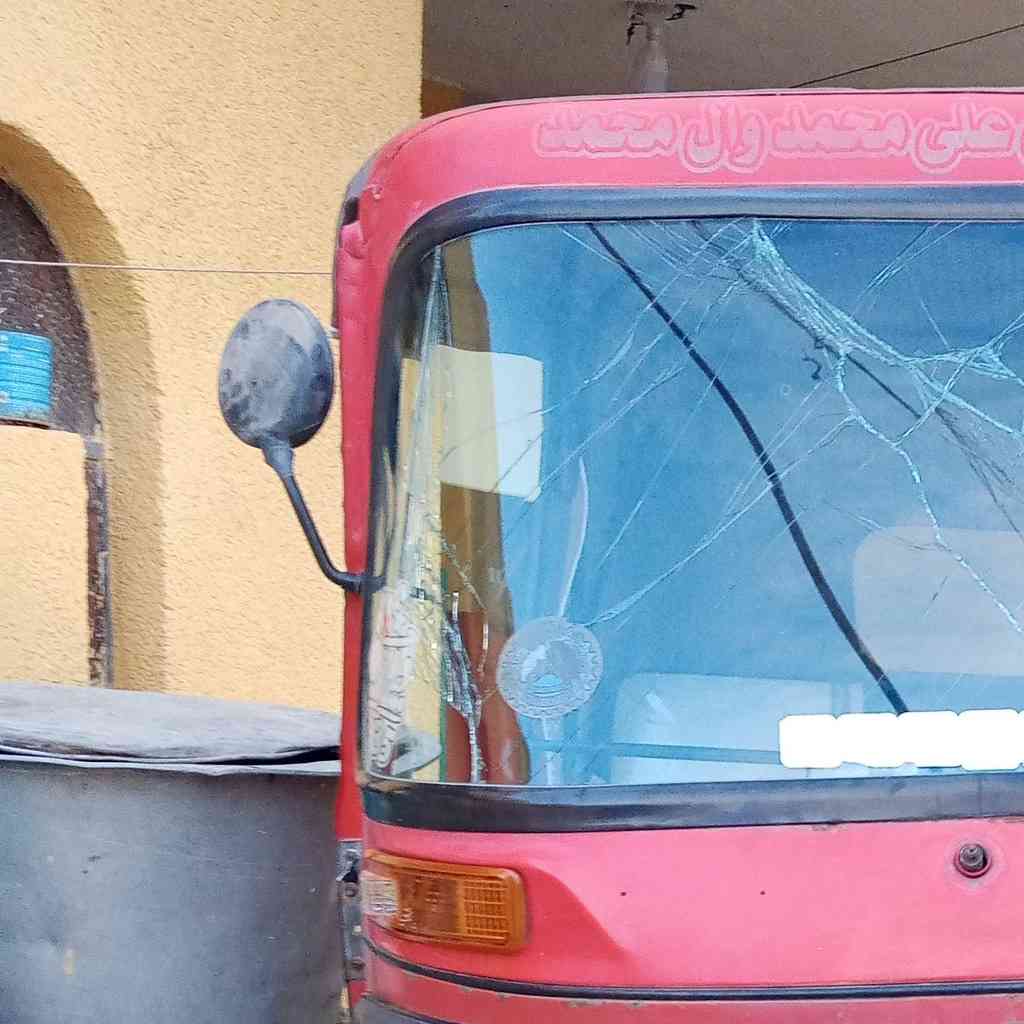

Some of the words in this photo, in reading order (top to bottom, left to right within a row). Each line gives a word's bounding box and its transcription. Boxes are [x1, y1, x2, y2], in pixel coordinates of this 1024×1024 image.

[535, 107, 679, 158] محمد
[770, 104, 909, 159] محمد
[911, 101, 1016, 174] على
